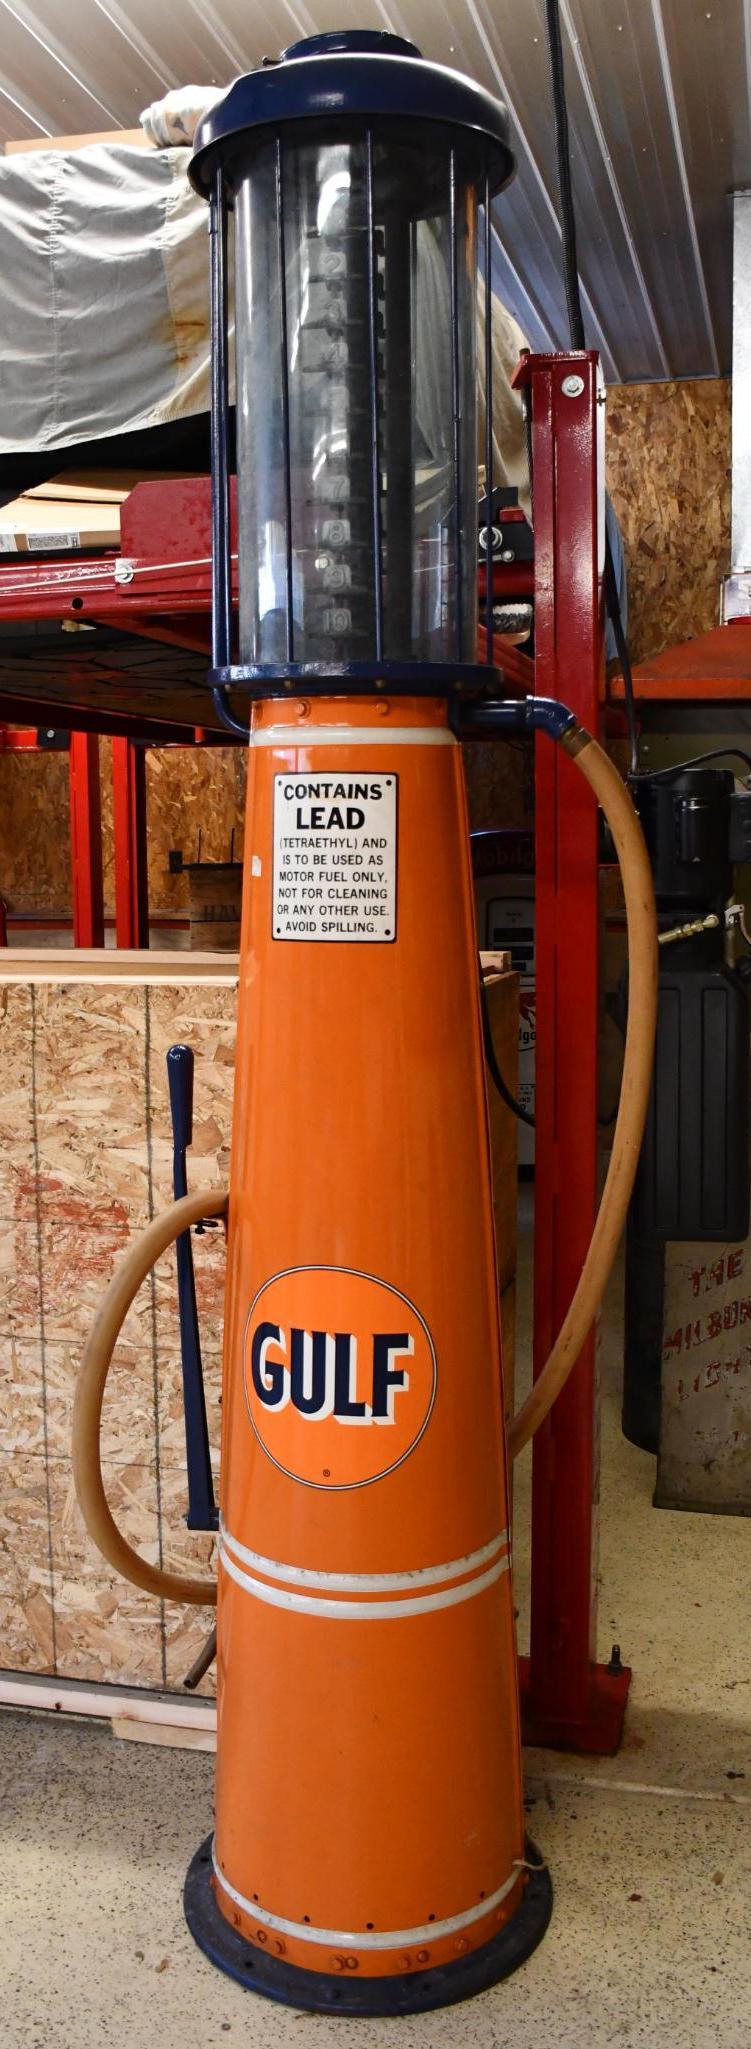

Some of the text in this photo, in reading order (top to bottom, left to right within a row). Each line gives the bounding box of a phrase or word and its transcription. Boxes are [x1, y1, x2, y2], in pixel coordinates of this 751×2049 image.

[324, 254, 341, 273] 2
[328, 521, 345, 545] 8
[325, 611, 348, 633] 10
[284, 783, 383, 801] CONTAINS
[296, 807, 366, 830] LEAD
[279, 837, 387, 850] (TETRAETHYL) AND
[282, 854, 384, 865] IS TO BE USED AS
[279, 871, 388, 883] MOTOR FUEL ONLY,
[278, 888, 388, 899] NOT FOR CLEANING
[277, 904, 390, 916] OR ANY OTHER USE.
[285, 921, 378, 933] AVOID SPILLING.
[251, 1321, 415, 1426] GULF
